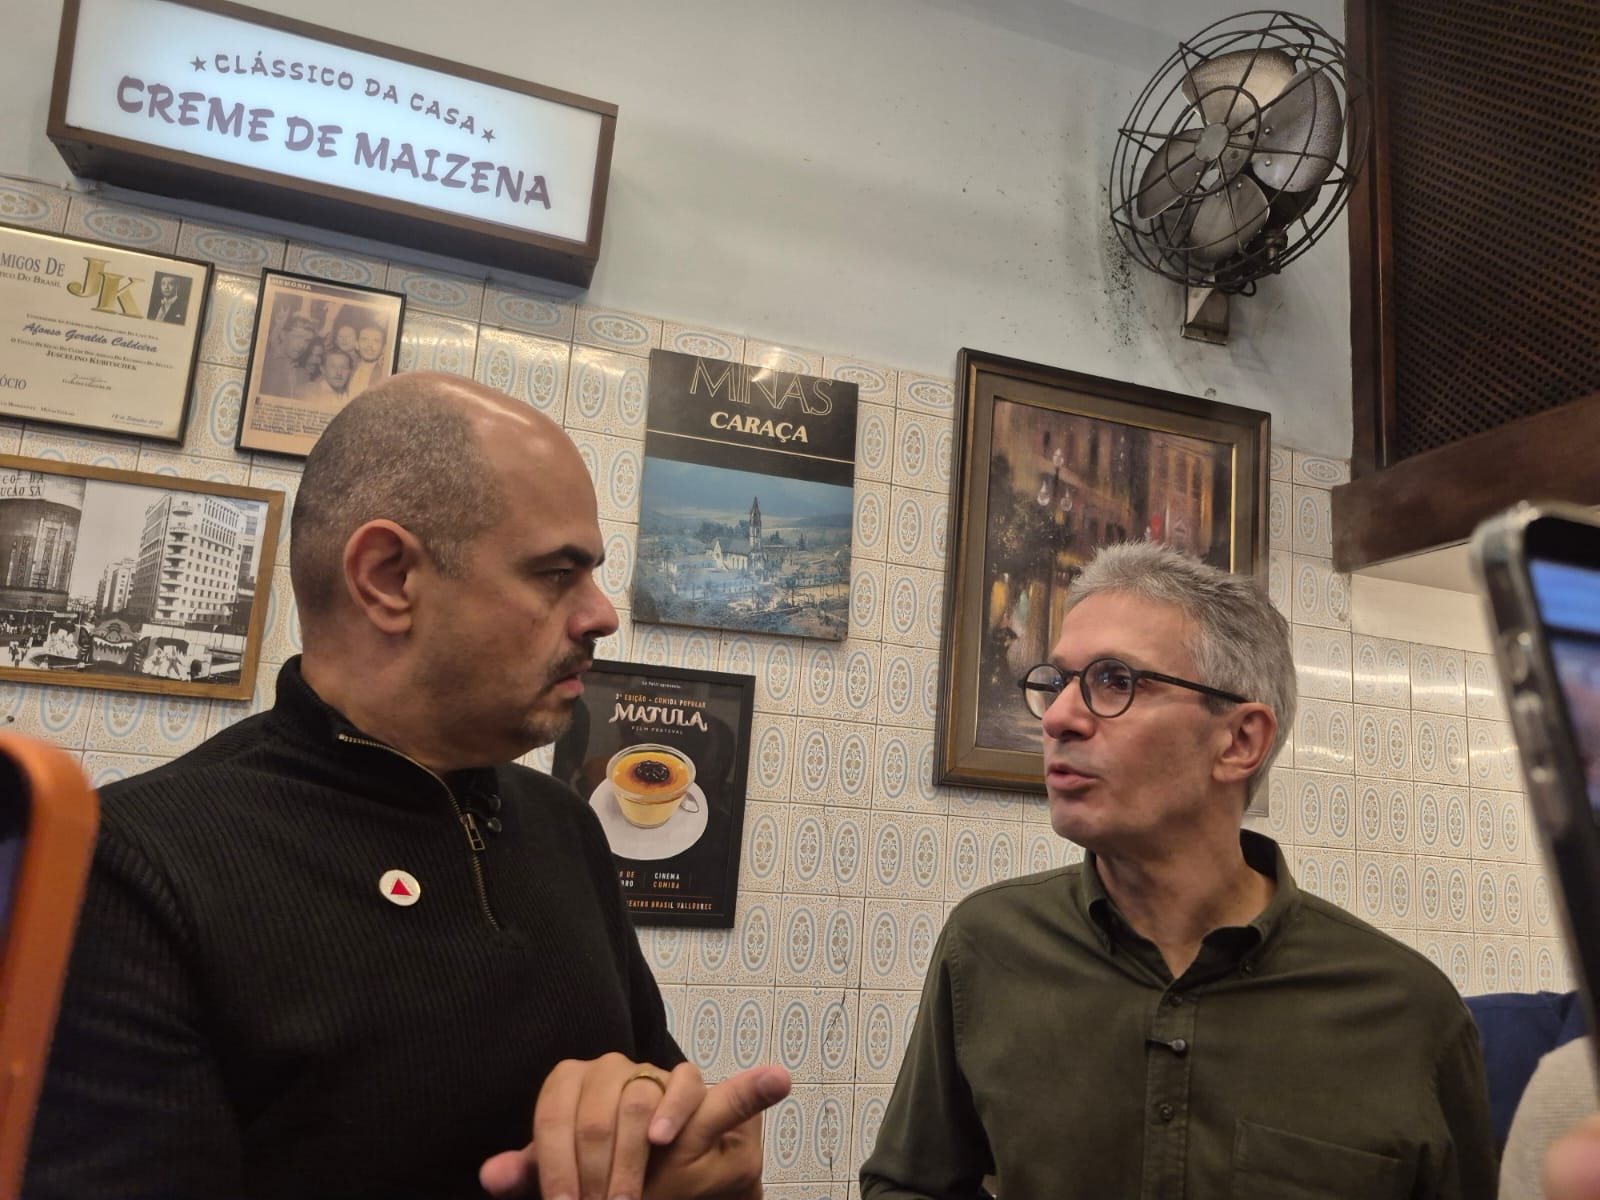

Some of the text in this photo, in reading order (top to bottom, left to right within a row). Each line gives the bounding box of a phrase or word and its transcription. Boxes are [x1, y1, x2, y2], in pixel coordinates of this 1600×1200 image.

[214, 51, 475, 135] CLÁSSICO DA CASA
[117, 75, 552, 209] CREME DE MAIZENA
[23, 322, 61, 336] Afonso
[64, 329, 107, 344] Geraldo
[111, 336, 158, 353] Caldeira
[690, 356, 833, 415] MINAS
[710, 411, 809, 443] CARAÇA
[654, 697, 677, 705] COMIDA
[608, 702, 708, 732] MATULA
[653, 881, 680, 889] COMIDA
[654, 872, 680, 880] CINEMA
